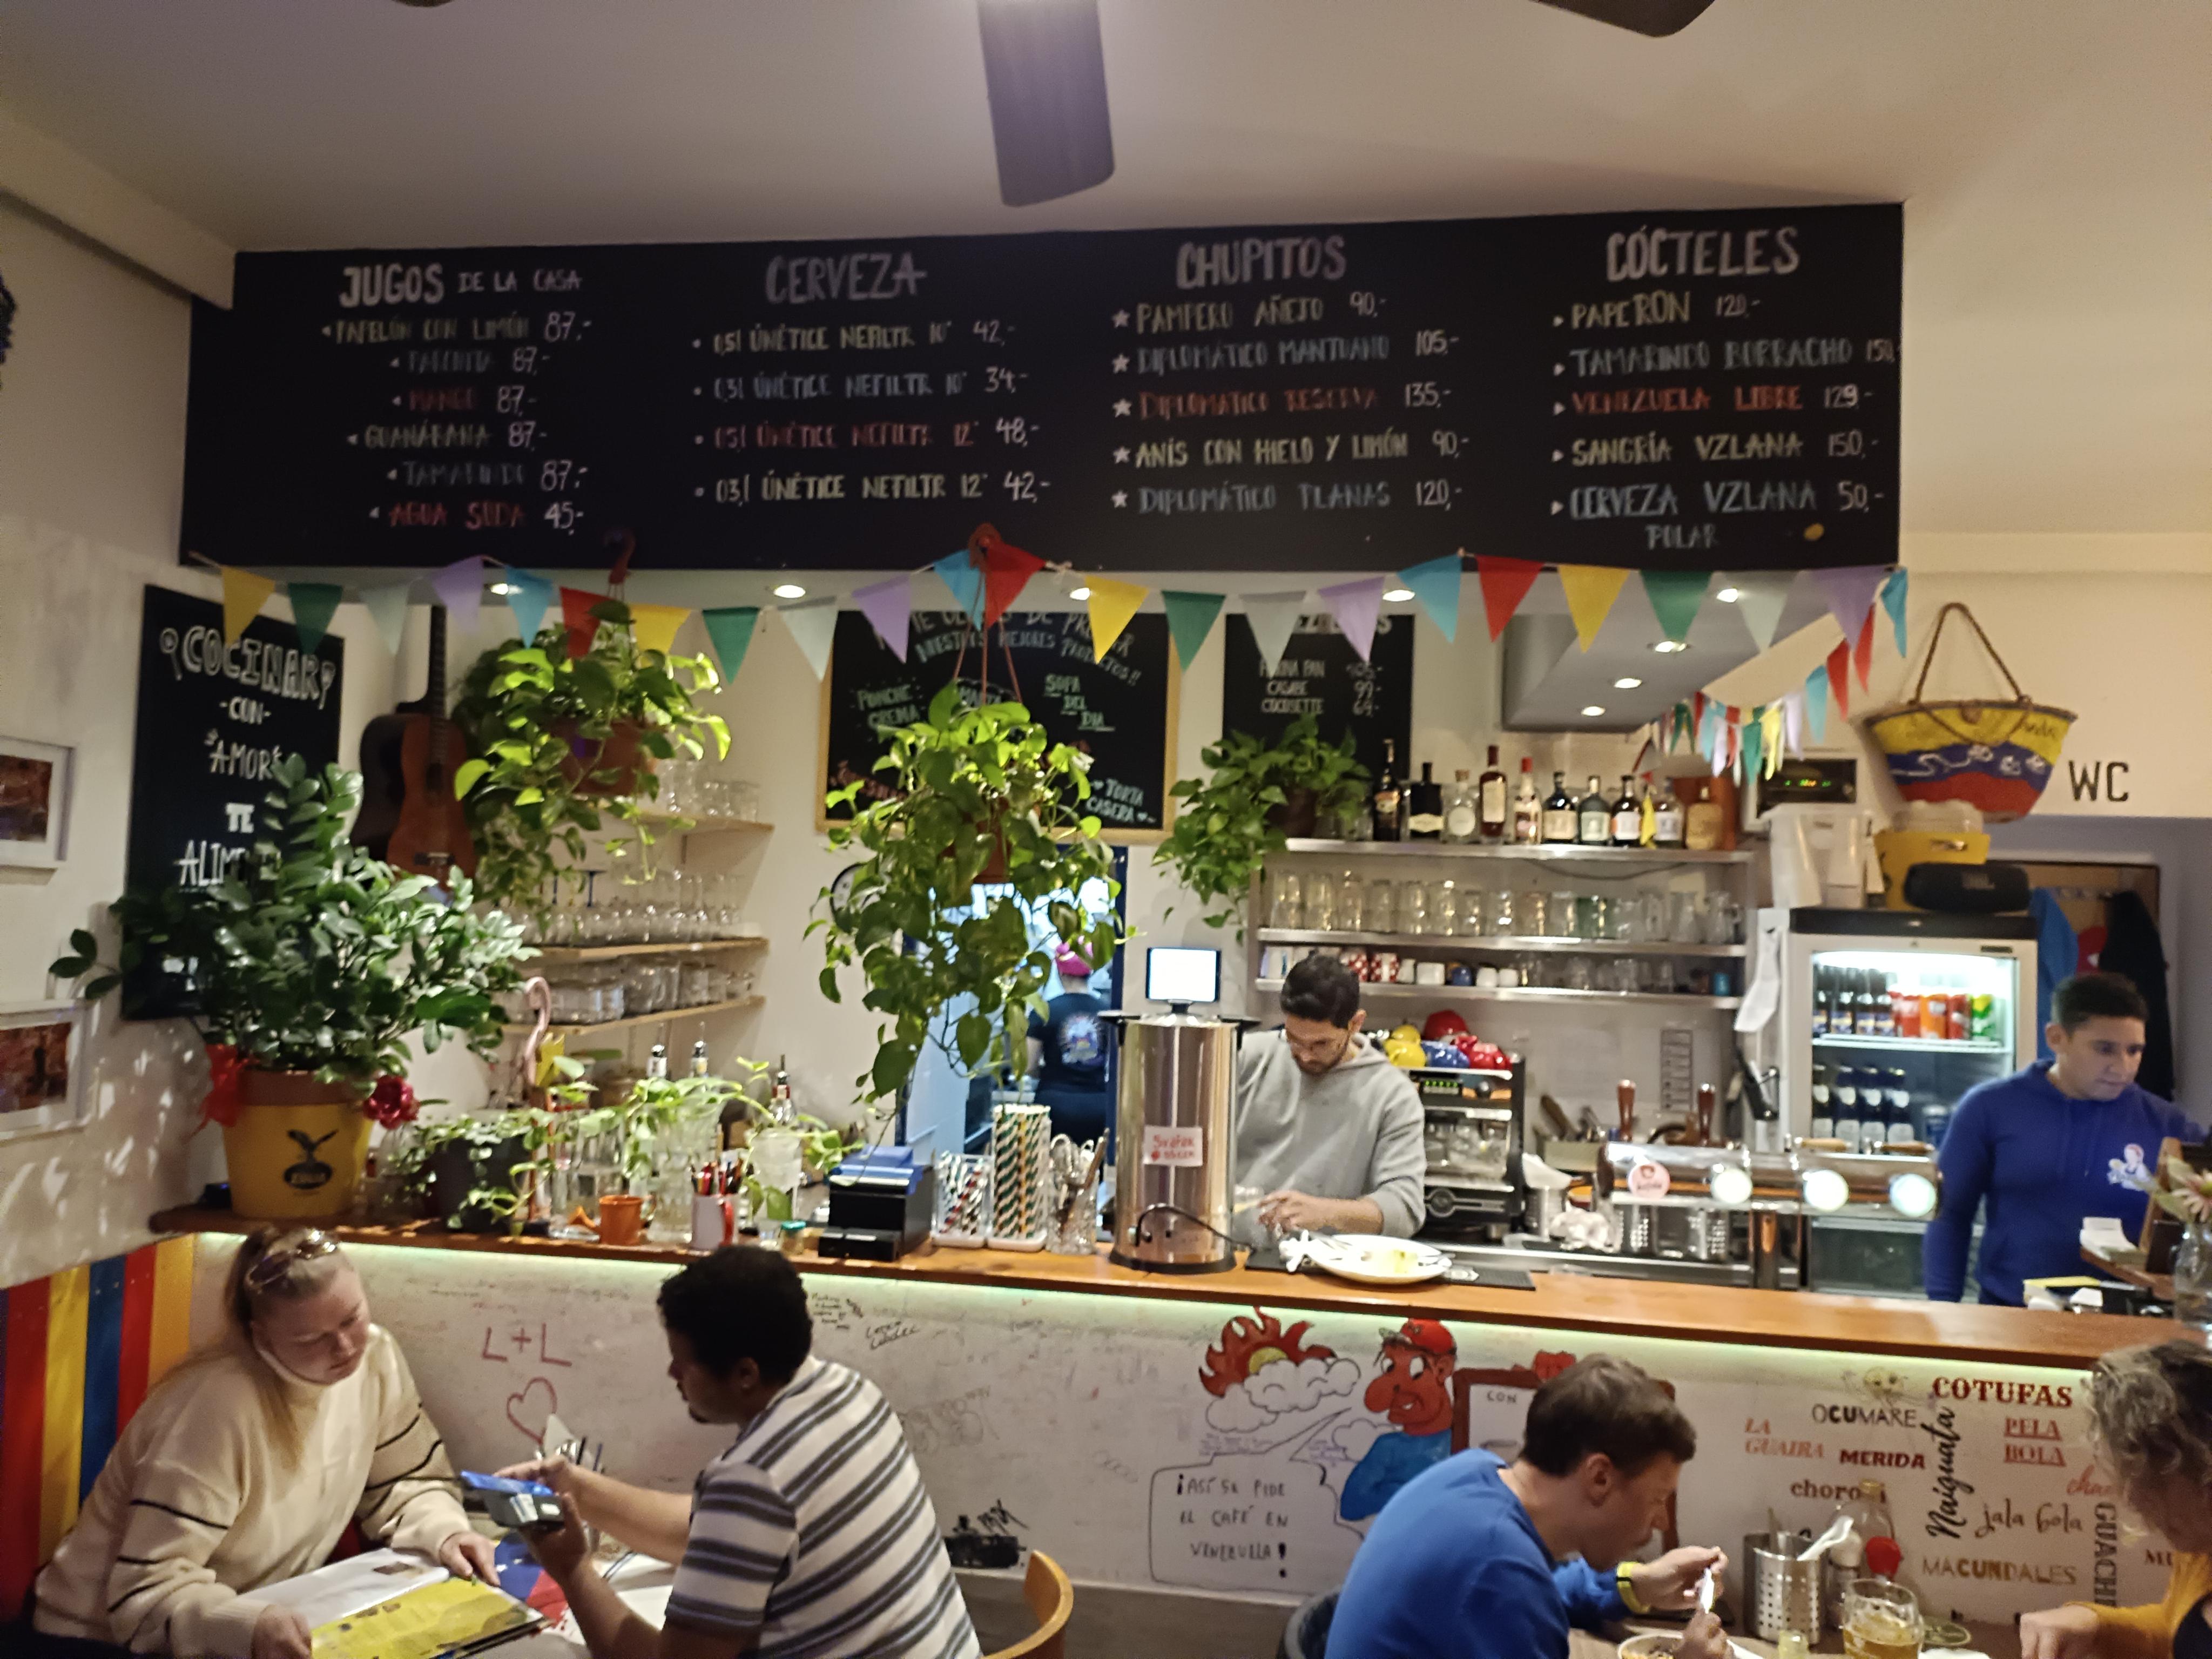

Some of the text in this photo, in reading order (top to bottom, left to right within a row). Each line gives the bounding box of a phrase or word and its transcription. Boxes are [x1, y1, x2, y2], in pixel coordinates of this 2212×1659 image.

[1176, 234, 1347, 289] CHUPITOS
[1606, 224, 1799, 281] CÓCTELES
[339, 263, 582, 308] JUGOS DE LA CASA
[765, 252, 927, 304] CERVEZA
[1136, 301, 1233, 334] PAMPERO
[1255, 294, 1323, 327] AÑEJO
[1135, 437, 1188, 468] ANÍS
[1203, 439, 1241, 466] CON
[1253, 436, 1313, 466] HIELO
[1325, 434, 1340, 463] Y
[1352, 426, 1408, 460] LIMÓN
[1572, 431, 1673, 467] SANGRÍA
[1694, 432, 1803, 461] VZLANA
[1570, 482, 1678, 520] CERVEZA
[1702, 480, 1817, 514] VZLANA
[2068, 760, 2130, 802] WC
[225, 802, 255, 834] TE
[1486, 1390, 1518, 1405] CON
[1932, 1376, 2073, 1408] COTUFAS
[1744, 1417, 1772, 1435] LA
[1812, 1403, 1918, 1428] OCUMARE
[2004, 1415, 2062, 1441] PELA
[1744, 1438, 1825, 1459] GUAIRA
[1839, 1448, 1926, 1470] MERIDA
[2004, 1442, 2067, 1468] BOLA
[1253, 1478, 1285, 1499] PIDE
[1921, 1555, 2078, 1586] MACUNDALES
